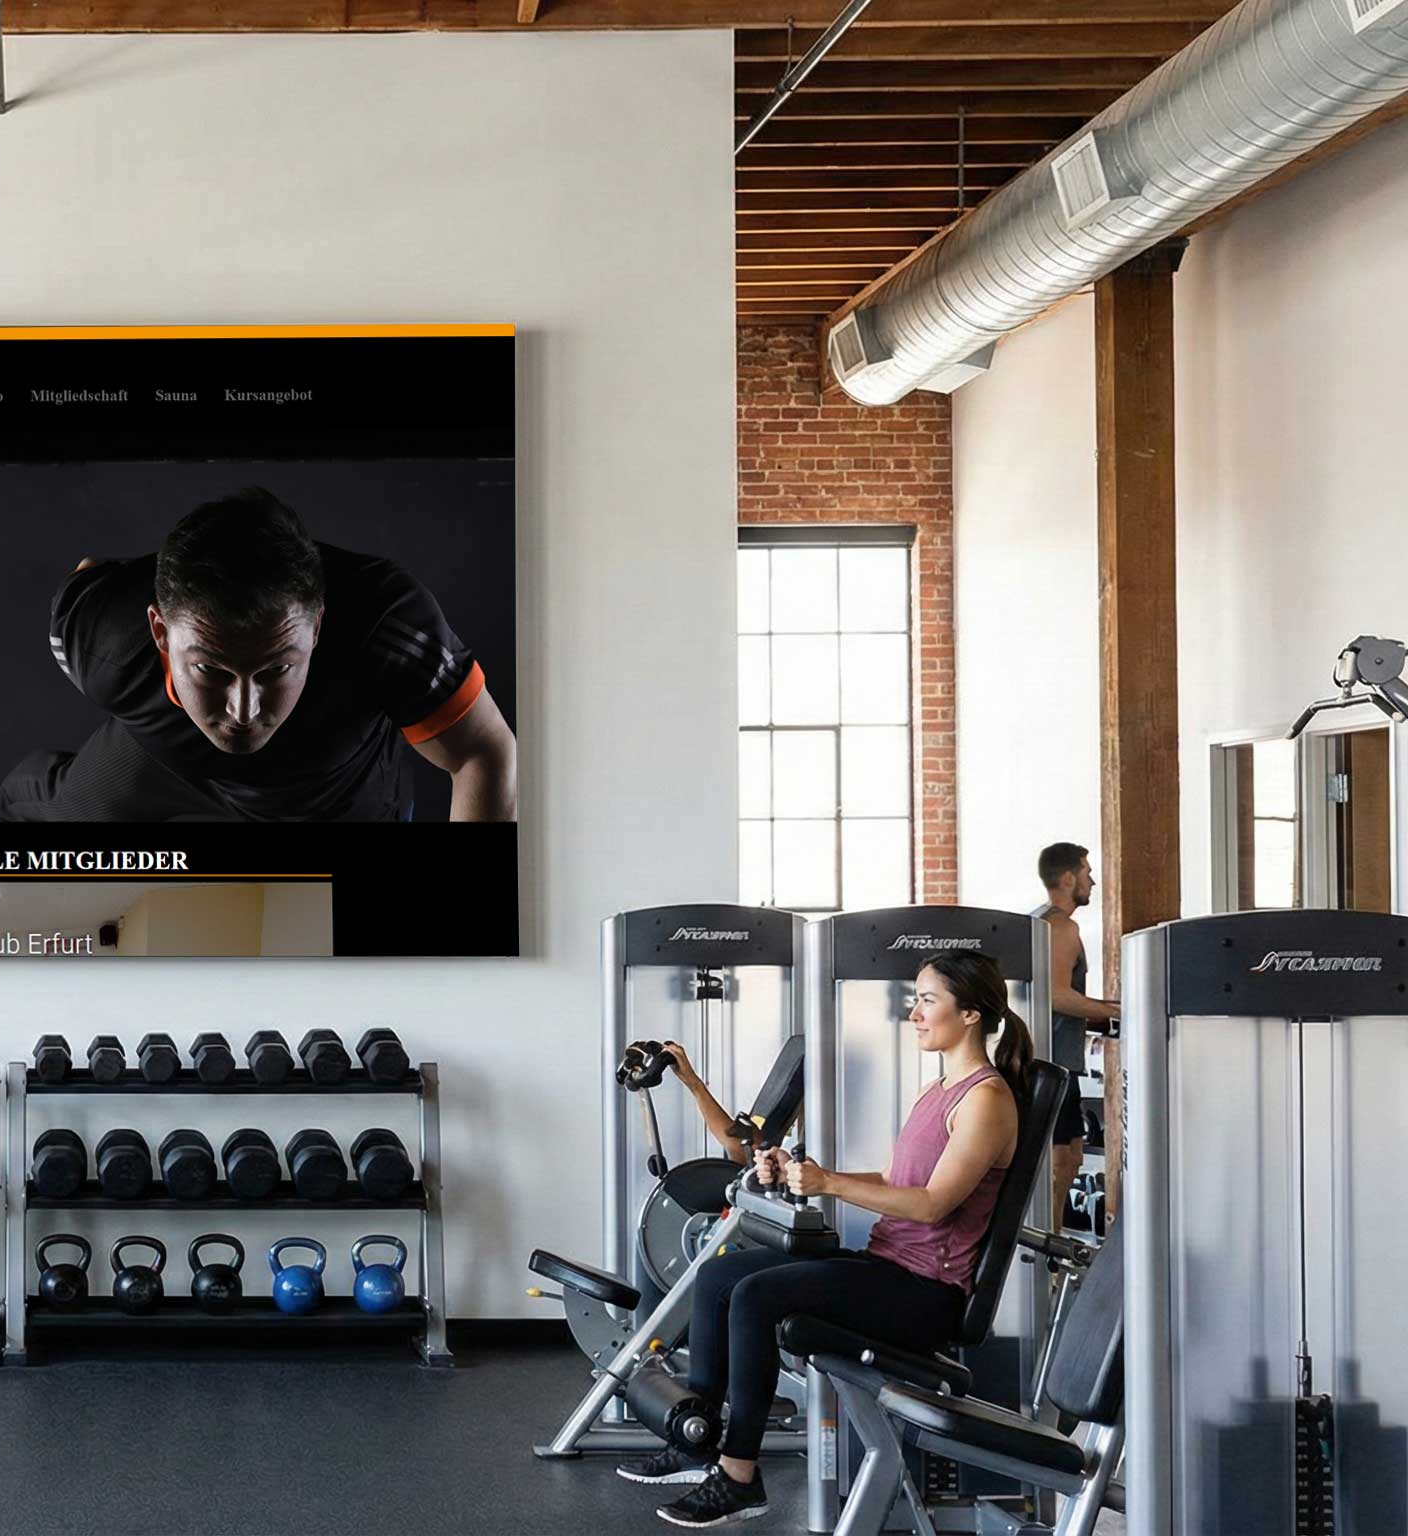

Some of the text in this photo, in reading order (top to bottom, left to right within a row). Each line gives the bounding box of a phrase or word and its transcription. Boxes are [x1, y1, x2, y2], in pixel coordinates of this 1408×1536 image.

[31, 389, 128, 405] Mitgliedschaft
[155, 389, 198, 401] Sauna
[225, 388, 313, 405] Kursangebot
[26, 851, 189, 870] MITGLIEDER
[28, 932, 93, 954] Erfurt
